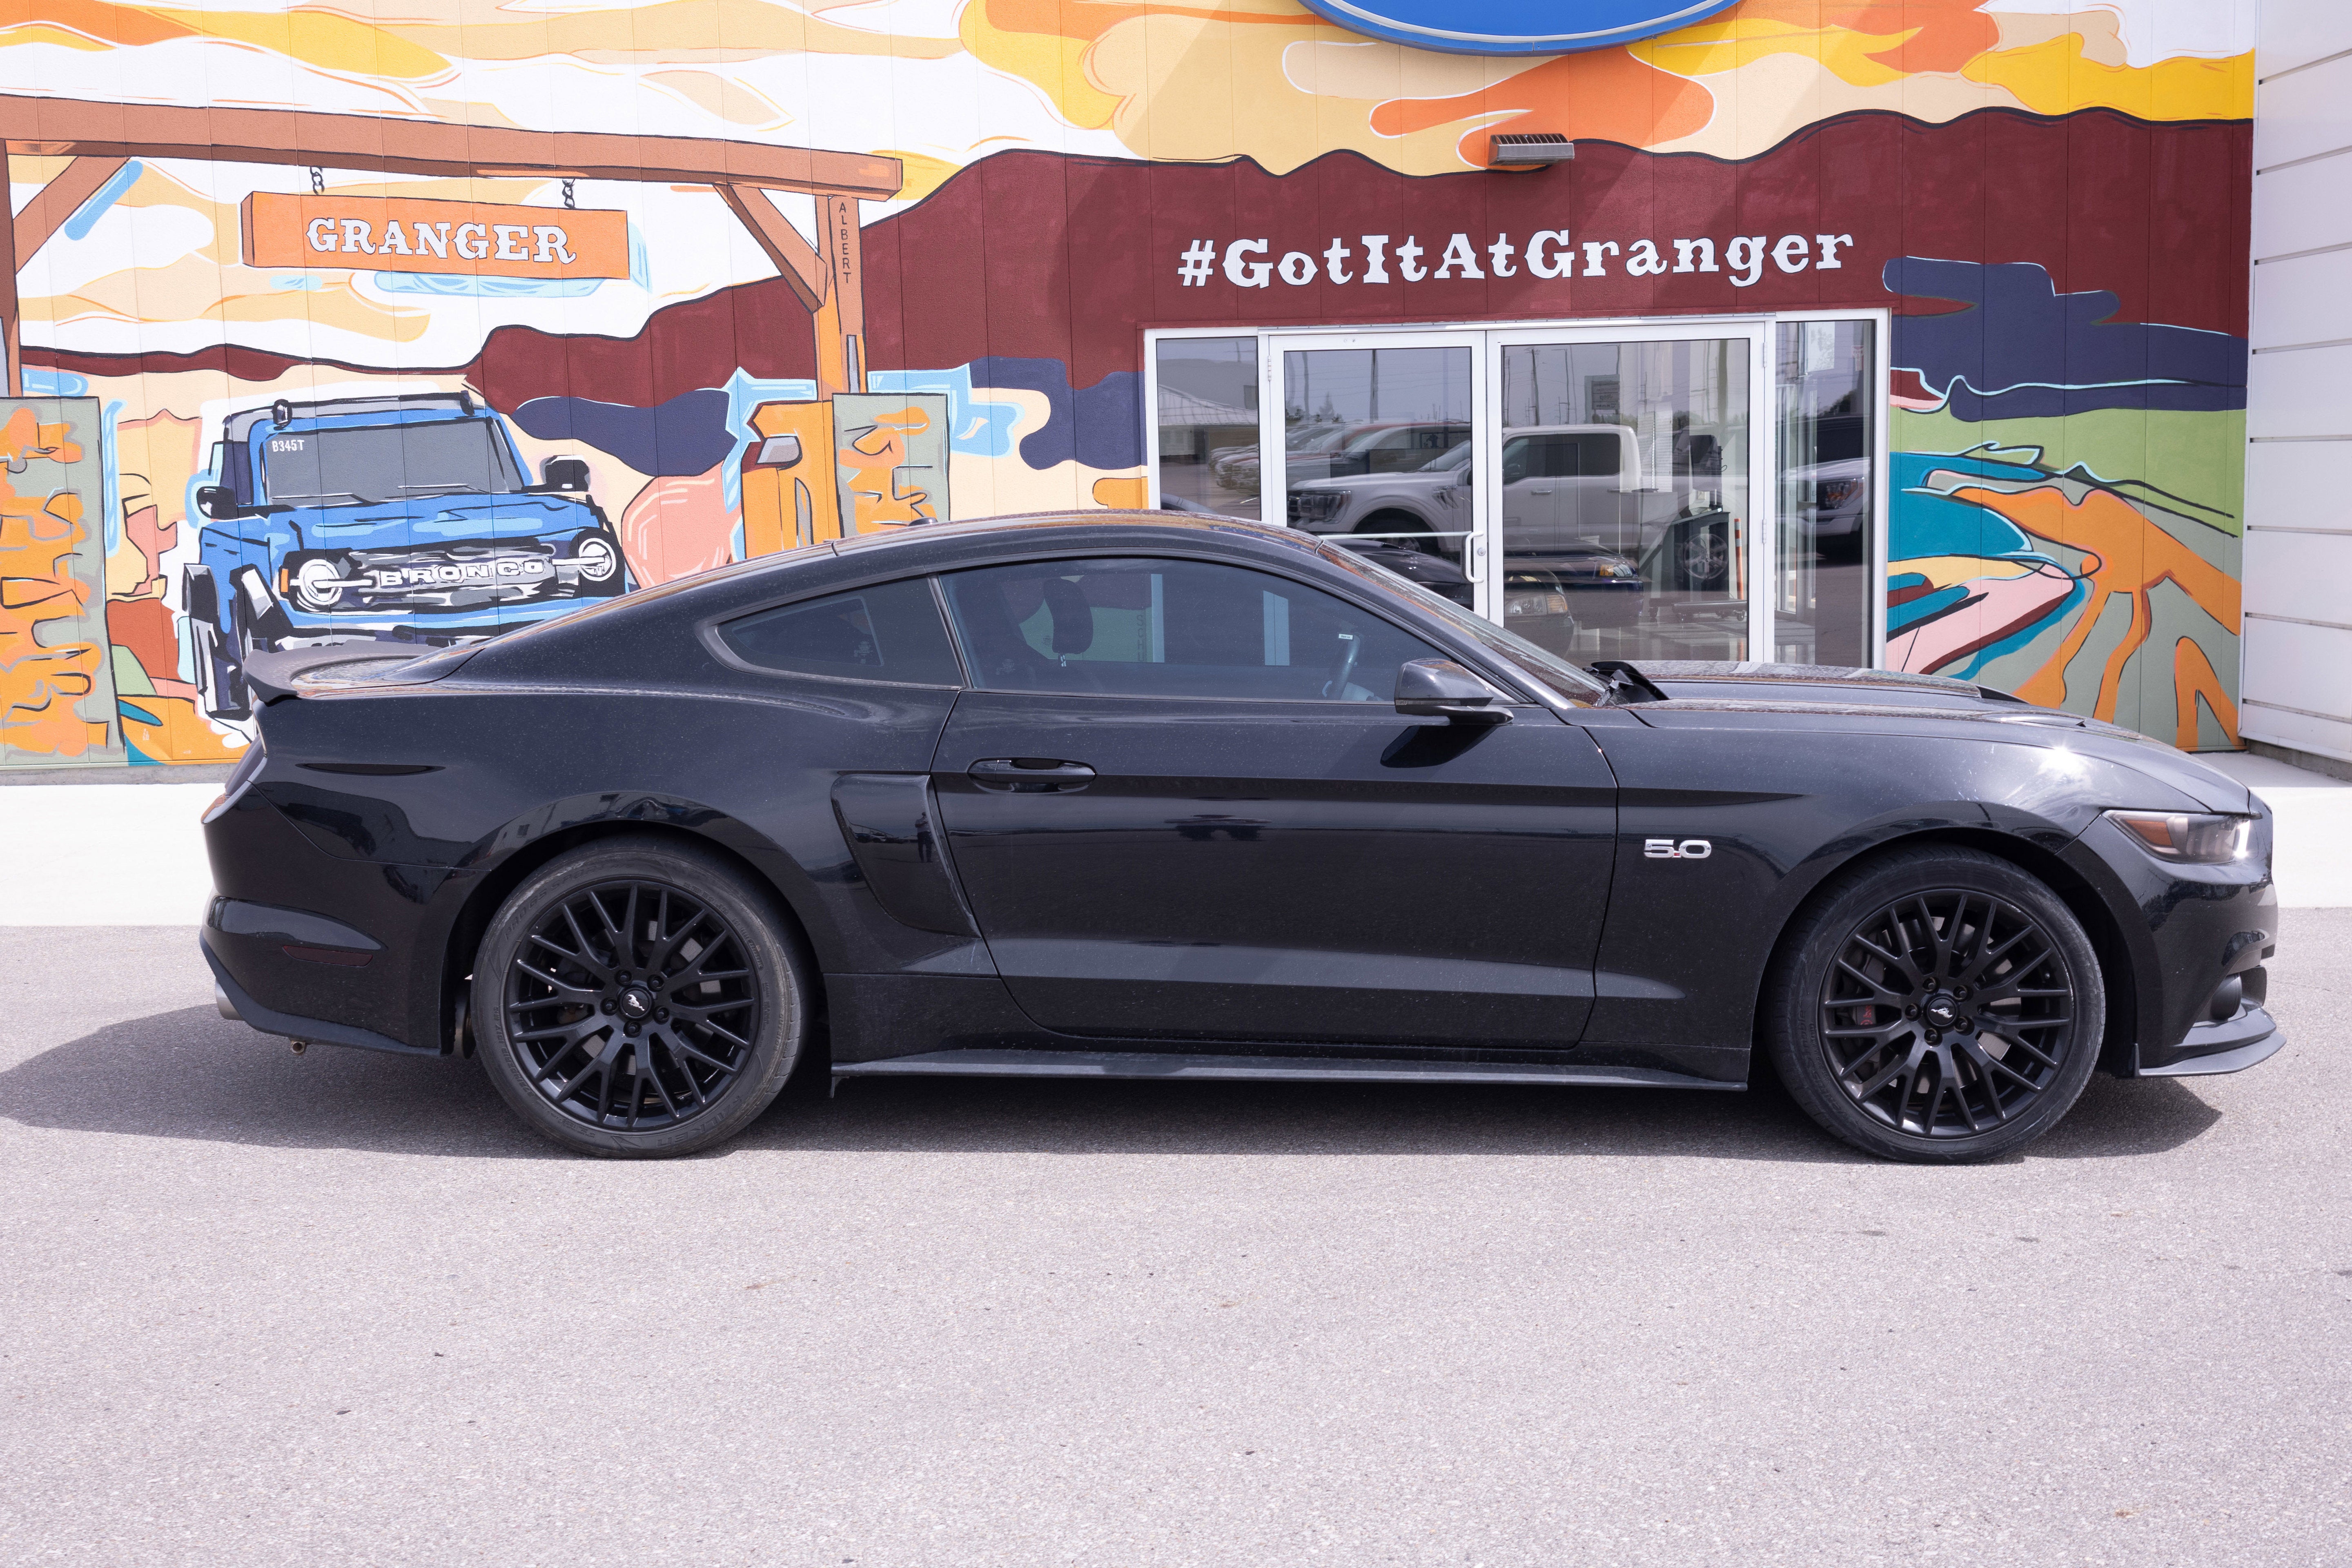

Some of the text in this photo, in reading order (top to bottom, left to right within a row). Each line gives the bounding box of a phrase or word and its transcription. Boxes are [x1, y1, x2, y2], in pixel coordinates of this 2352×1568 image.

[305, 217, 577, 265] GRANGER
[839, 202, 851, 283] ALBERT
[1177, 229, 1853, 288] #GotItAtGranger
[272, 439, 305, 452] B345T
[380, 559, 545, 587] BRONCO
[1644, 839, 1712, 859] 5.0
[655, 1092, 746, 1149] FALKEN
